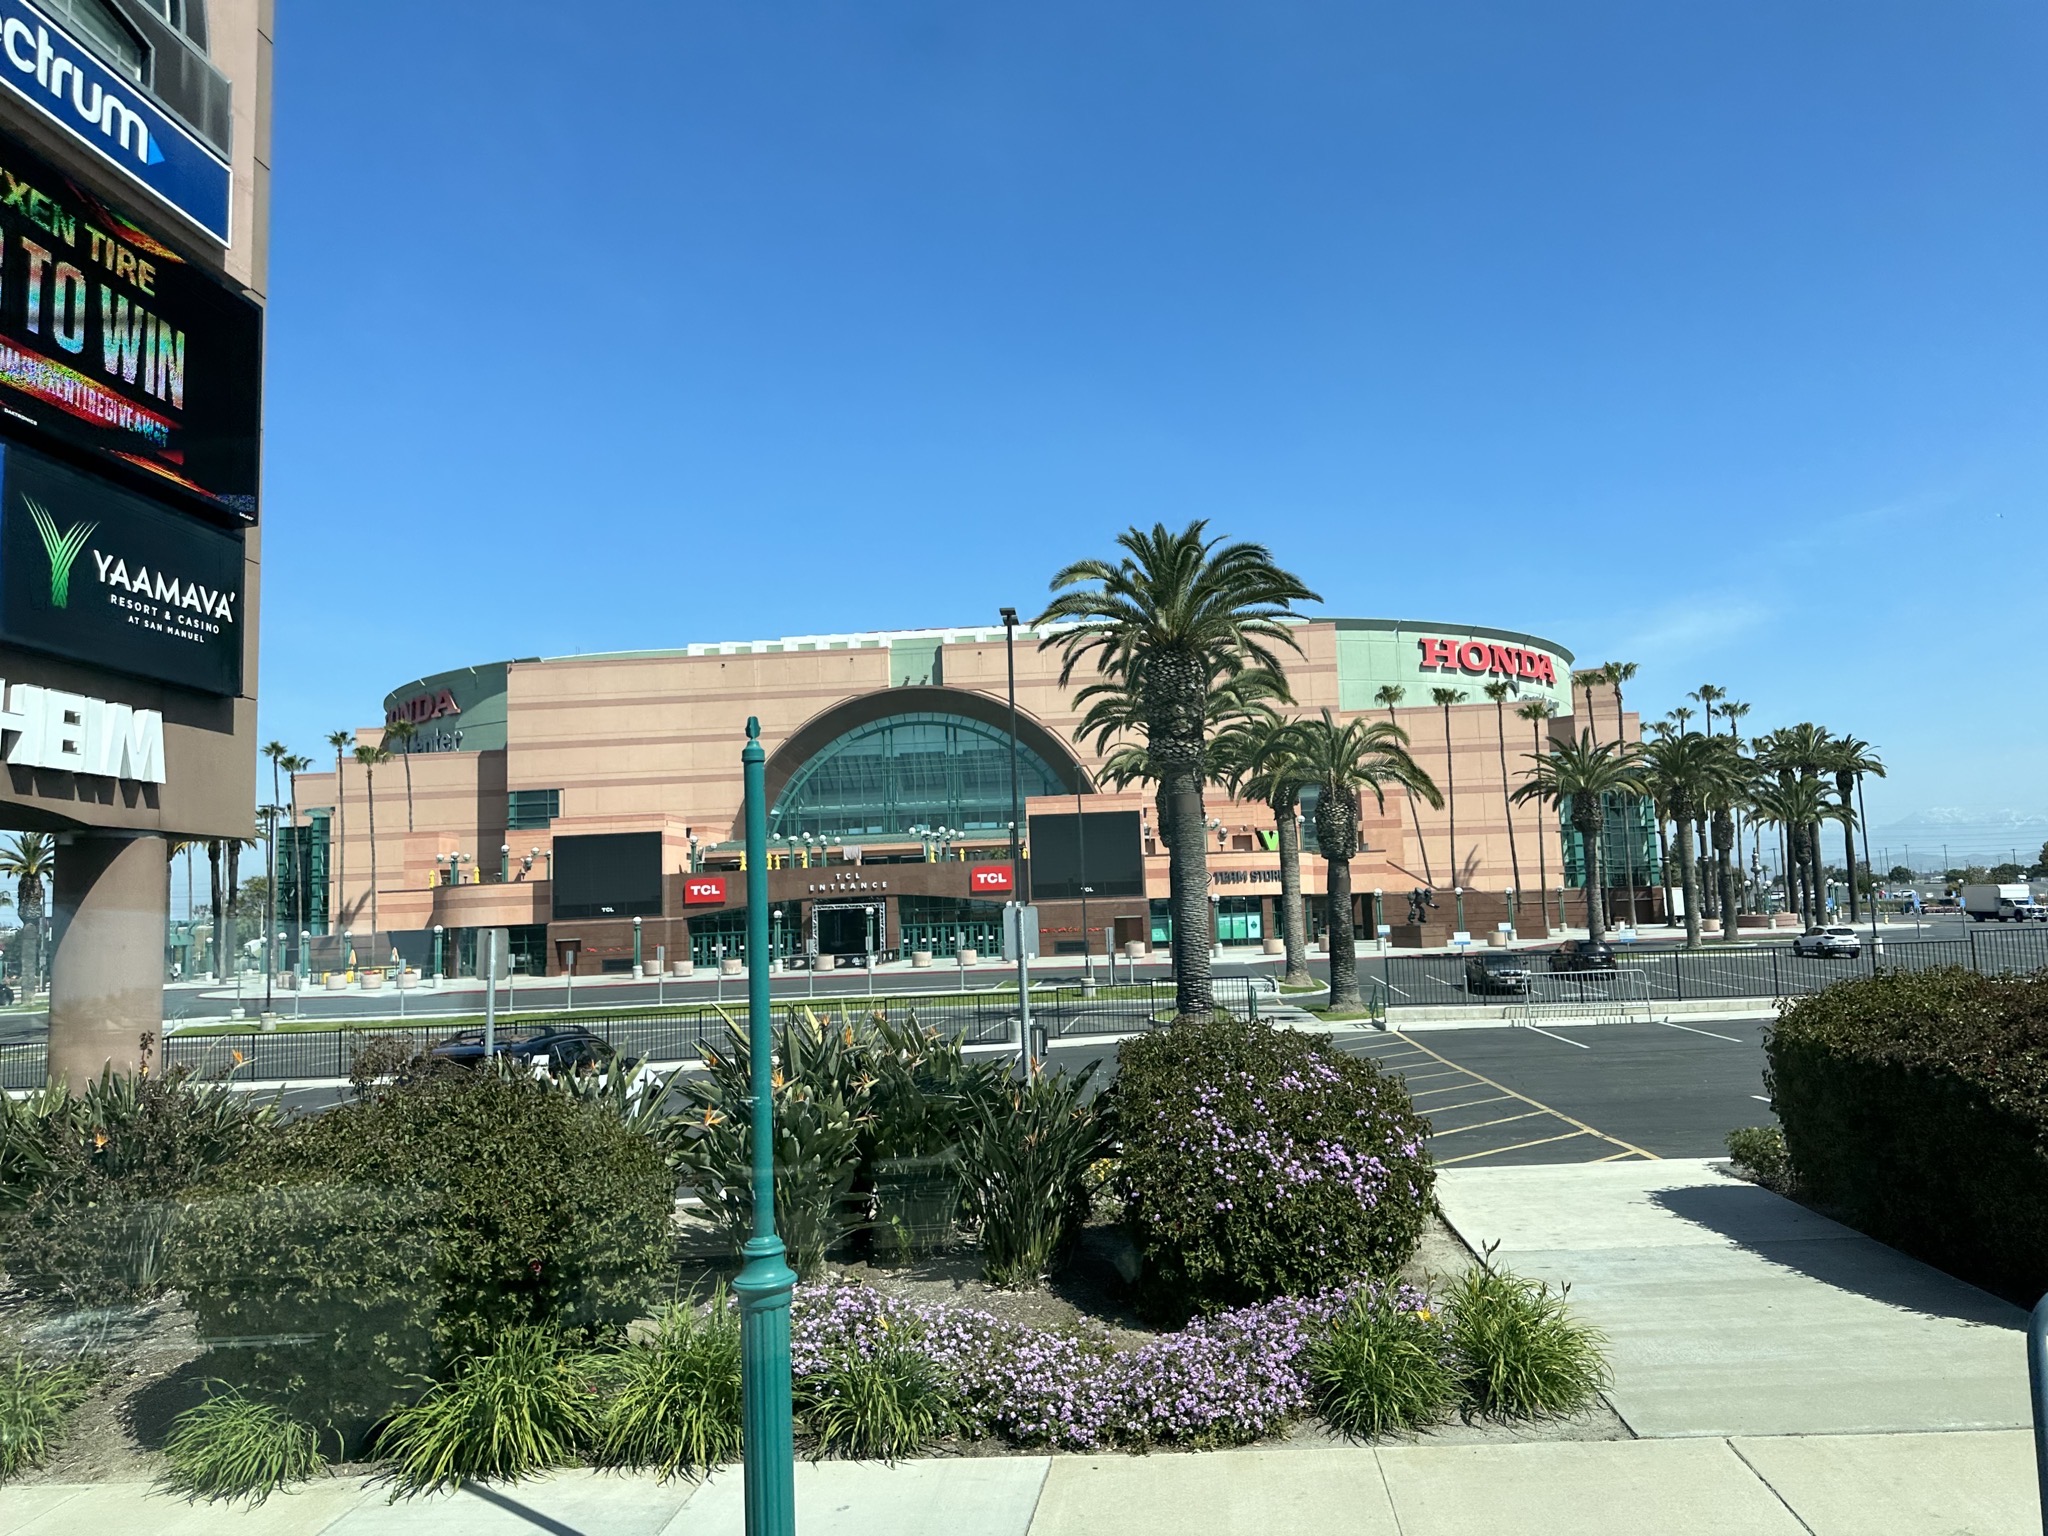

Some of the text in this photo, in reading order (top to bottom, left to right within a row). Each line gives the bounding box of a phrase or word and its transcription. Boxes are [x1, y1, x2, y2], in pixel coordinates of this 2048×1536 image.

[0, 13, 148, 164] ctrum
[0, 167, 75, 247] XEN
[85, 222, 156, 297] TIRE
[20, 235, 87, 355] TO
[101, 283, 185, 411] WIN
[110, 593, 220, 634] RESORT & CASINO
[128, 615, 205, 643] AT SAN MANUEL
[1420, 637, 1557, 684] HONDA
[690, 884, 721, 895] TCL
[809, 881, 887, 892] ENTRANCE
[977, 872, 1007, 884] TCL
[1213, 869, 1281, 885] TEAM STOR
